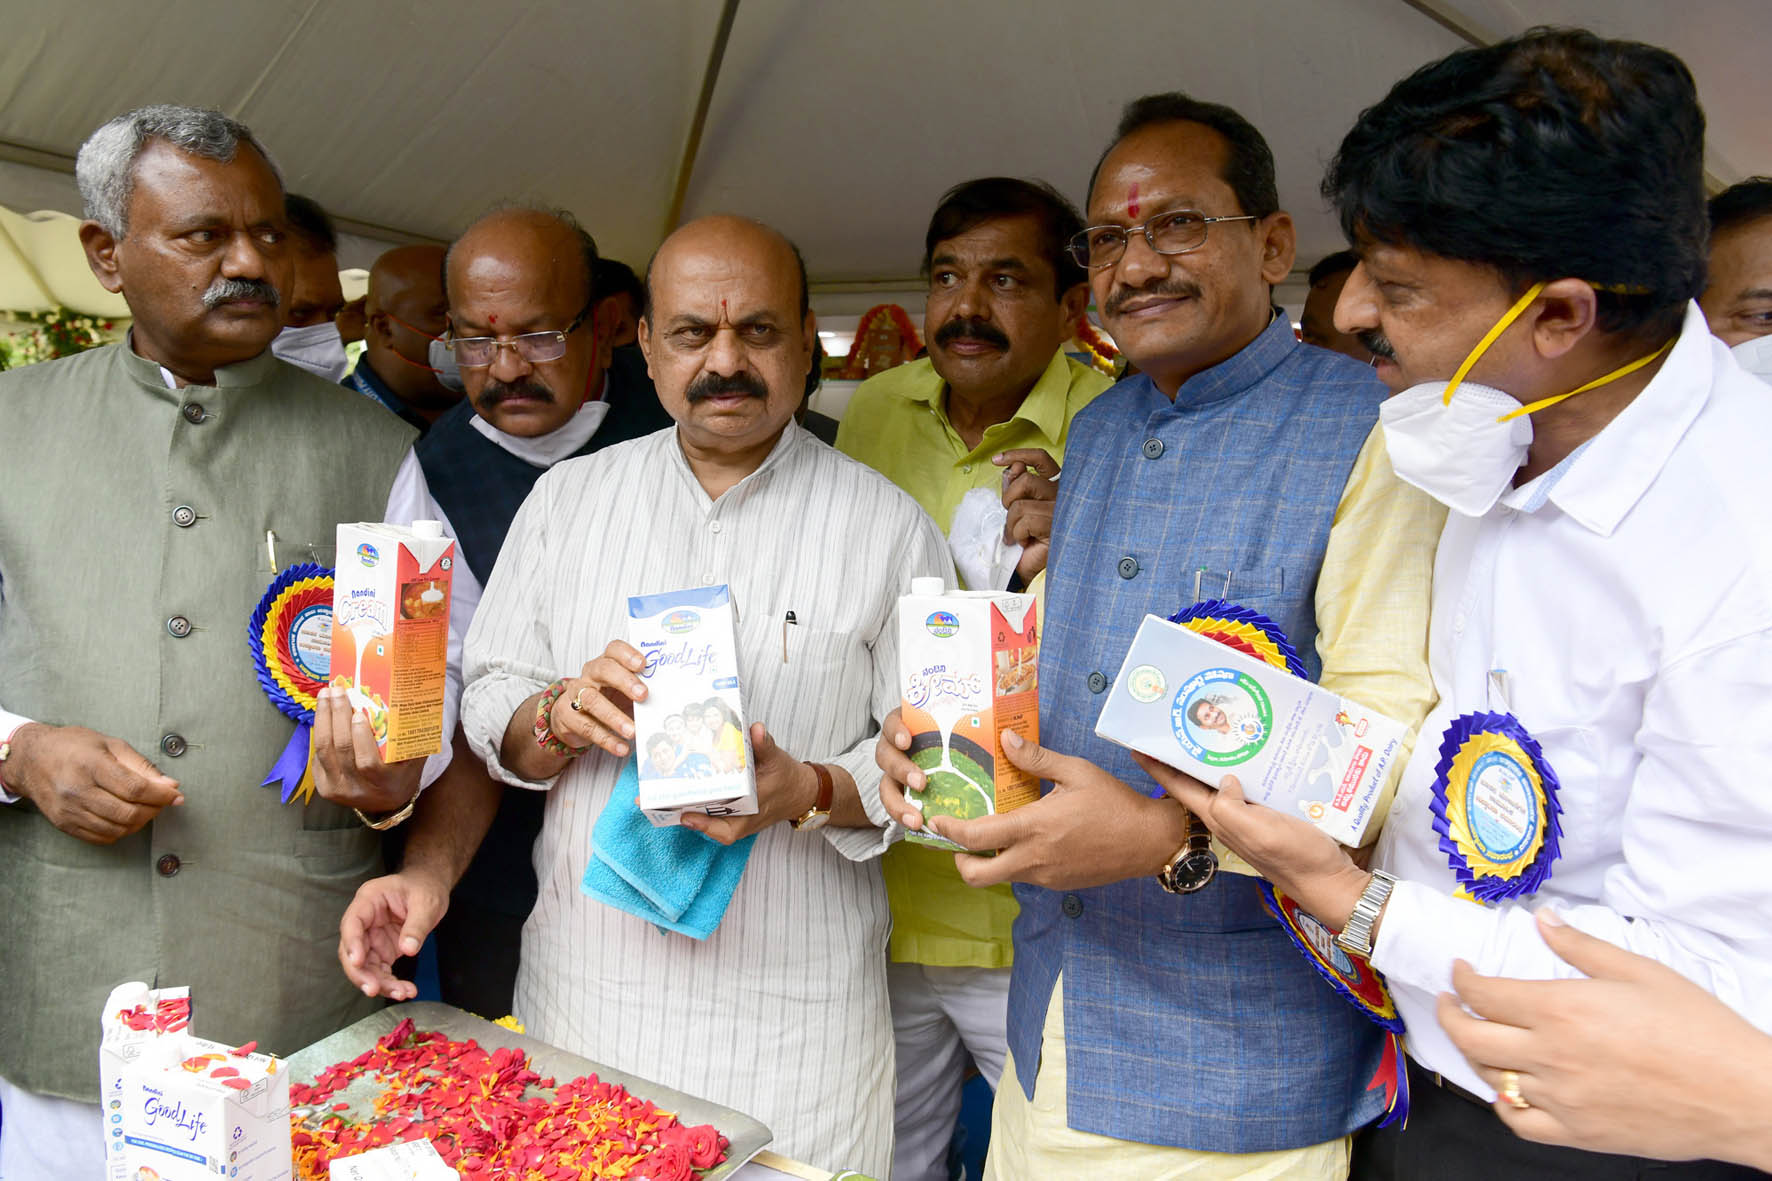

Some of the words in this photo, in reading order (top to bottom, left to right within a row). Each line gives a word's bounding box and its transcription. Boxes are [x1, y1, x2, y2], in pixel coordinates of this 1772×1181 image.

[338, 595, 387, 631] Cream
[1353, 803, 1369, 826] Quality
[1363, 776, 1379, 804] Product
[1383, 738, 1398, 757] Dairy
[144, 1097, 207, 1141] GoodLife
